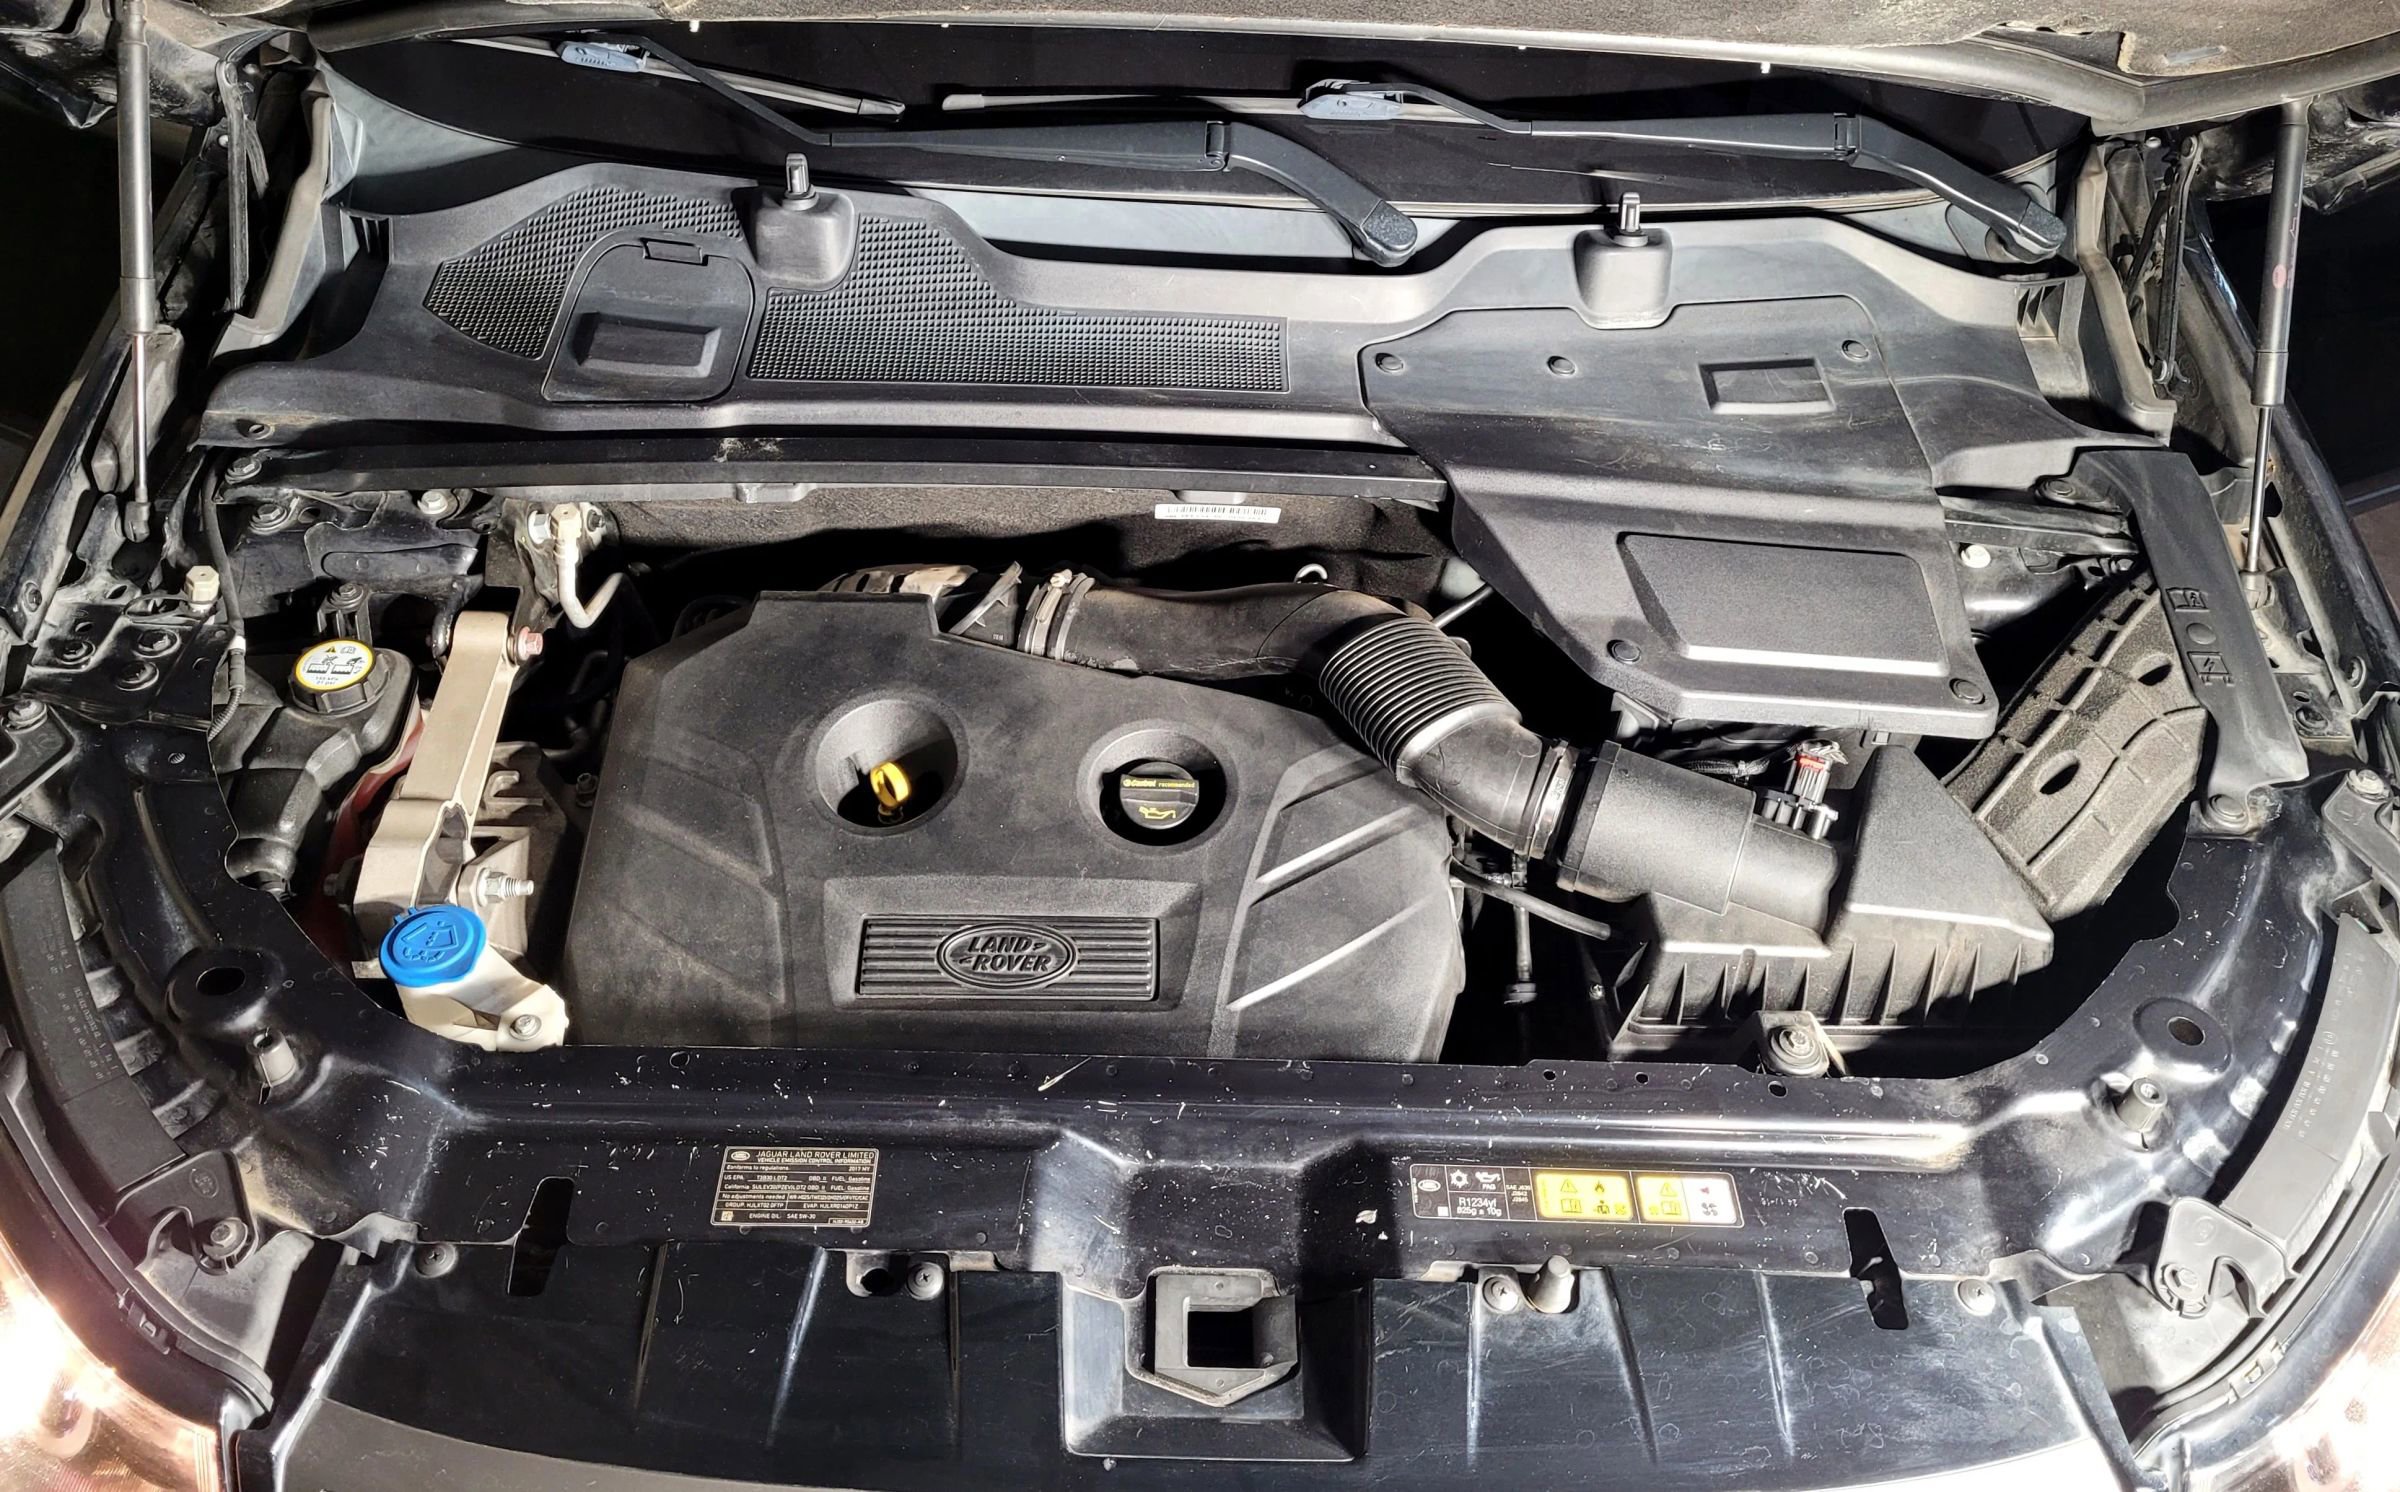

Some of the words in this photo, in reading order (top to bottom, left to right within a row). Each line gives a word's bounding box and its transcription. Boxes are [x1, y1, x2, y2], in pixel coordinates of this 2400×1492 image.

[967, 936, 1034, 953] LAND
[972, 954, 1053, 972] ROVER
[1459, 1197, 1497, 1208] R1234yf
[1487, 1207, 1502, 1216] 10g
